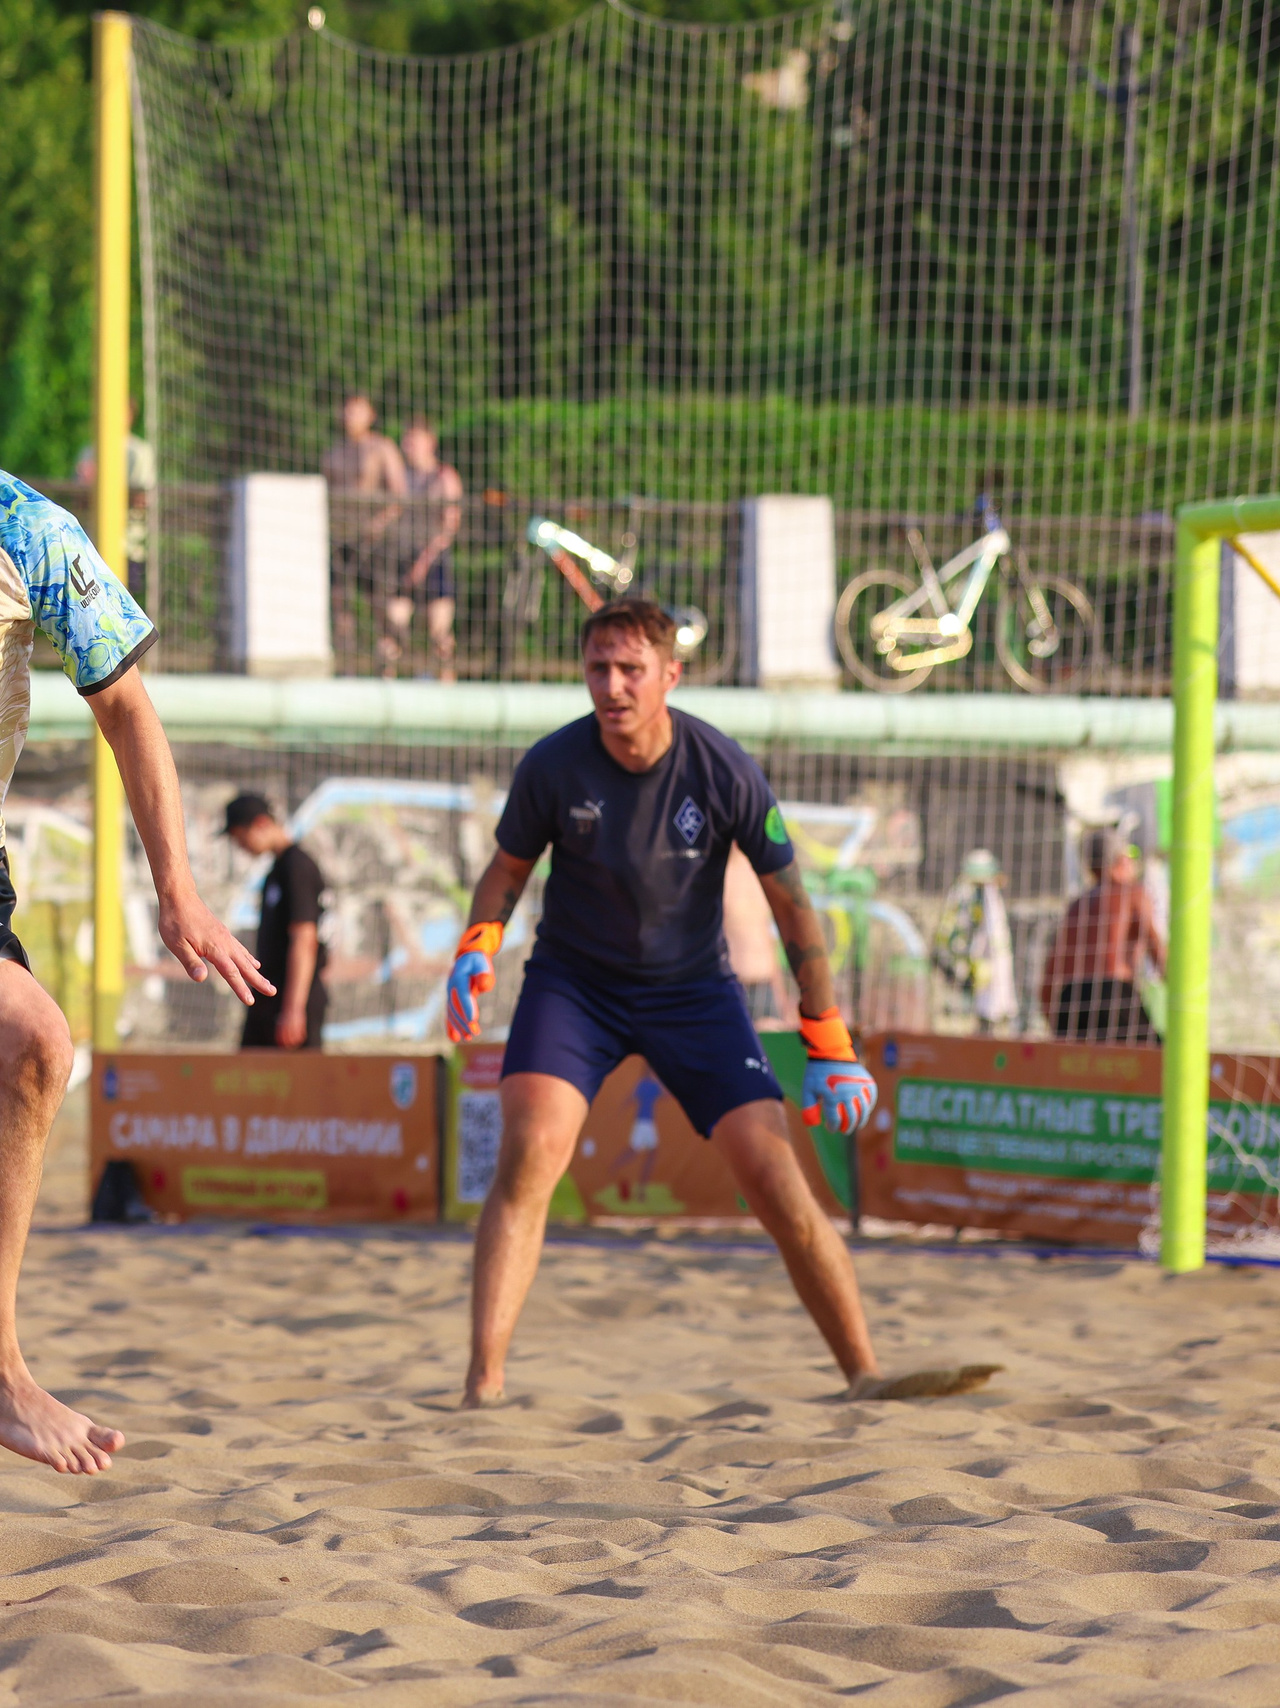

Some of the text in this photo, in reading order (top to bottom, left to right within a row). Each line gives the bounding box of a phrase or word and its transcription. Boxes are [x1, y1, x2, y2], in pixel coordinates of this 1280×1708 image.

[898, 1084, 1095, 1135] БЕСПЛАТНЫЕ
[110, 1112, 217, 1148] САМАРА
[244, 1115, 403, 1157] ДВИЖЕНИИ
